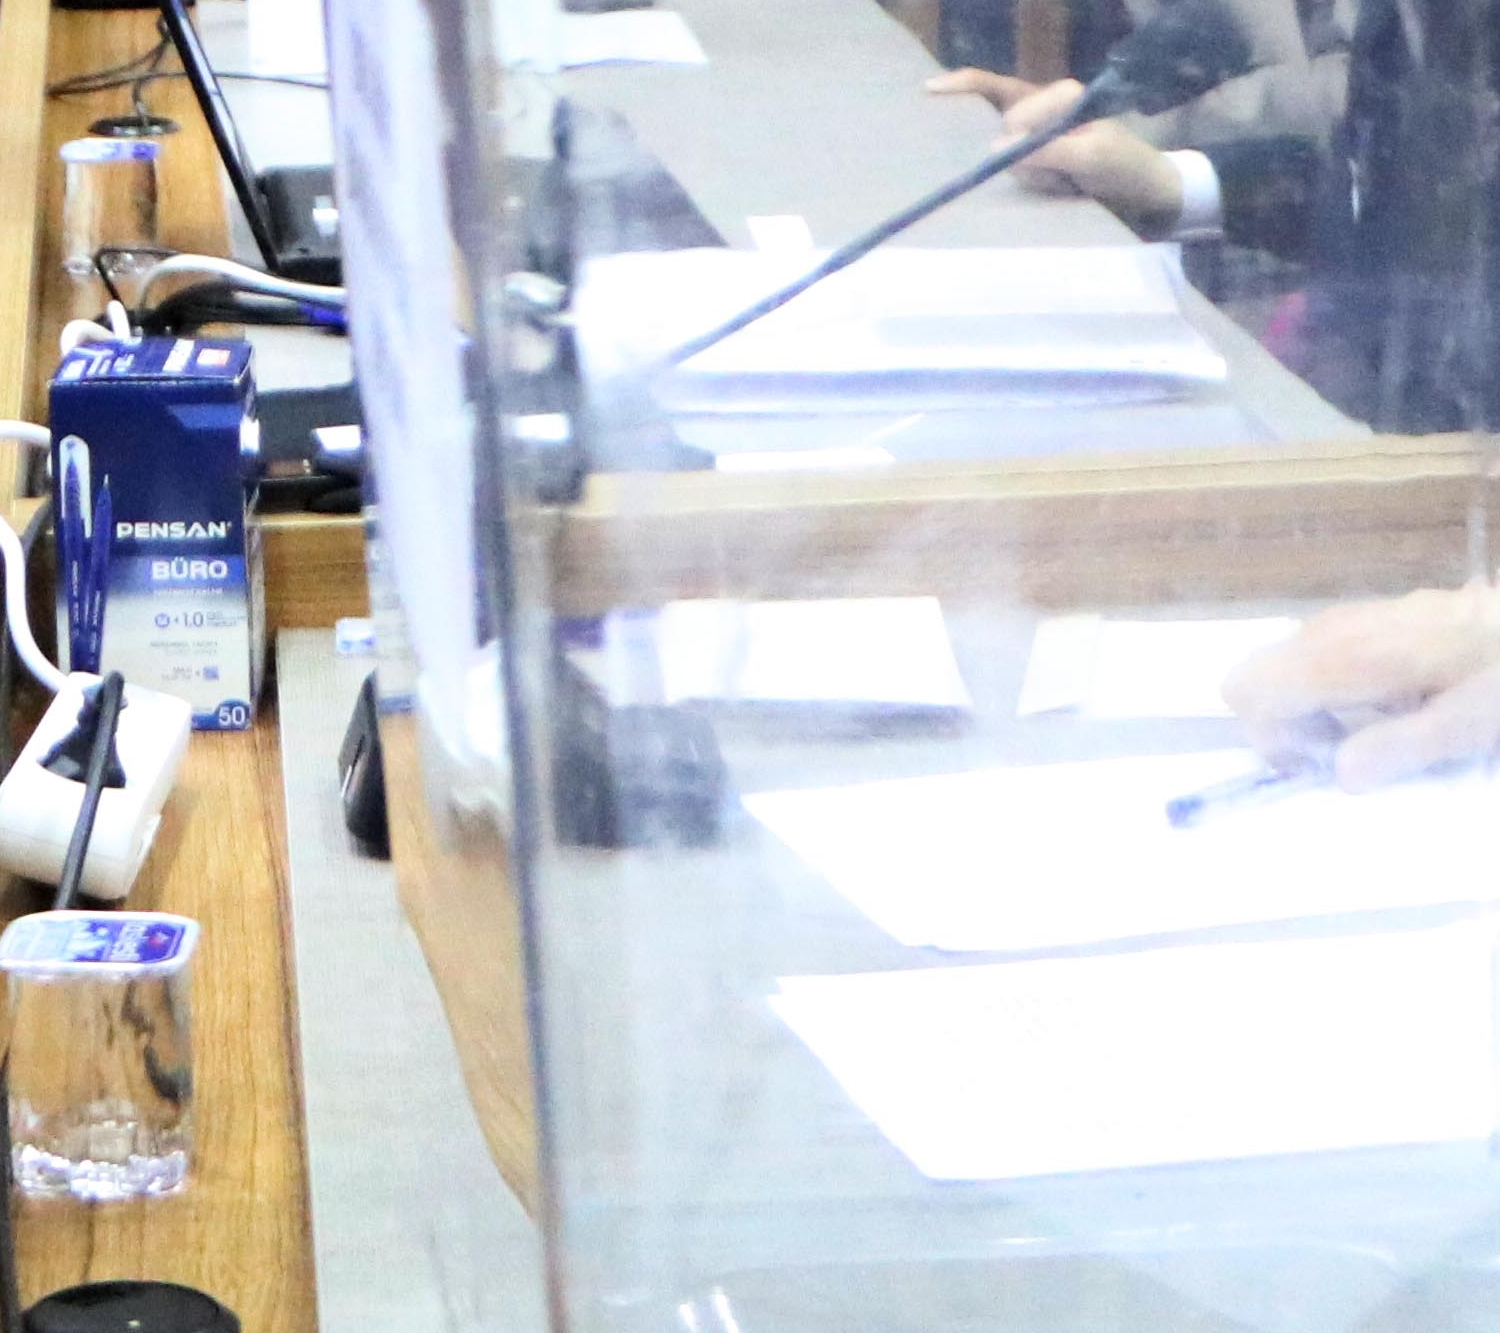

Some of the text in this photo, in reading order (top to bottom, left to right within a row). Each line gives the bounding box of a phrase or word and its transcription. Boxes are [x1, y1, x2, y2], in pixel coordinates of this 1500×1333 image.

[116, 521, 227, 539] PENSAN
[151, 556, 228, 580] BÜRO
[218, 706, 246, 726] 50
